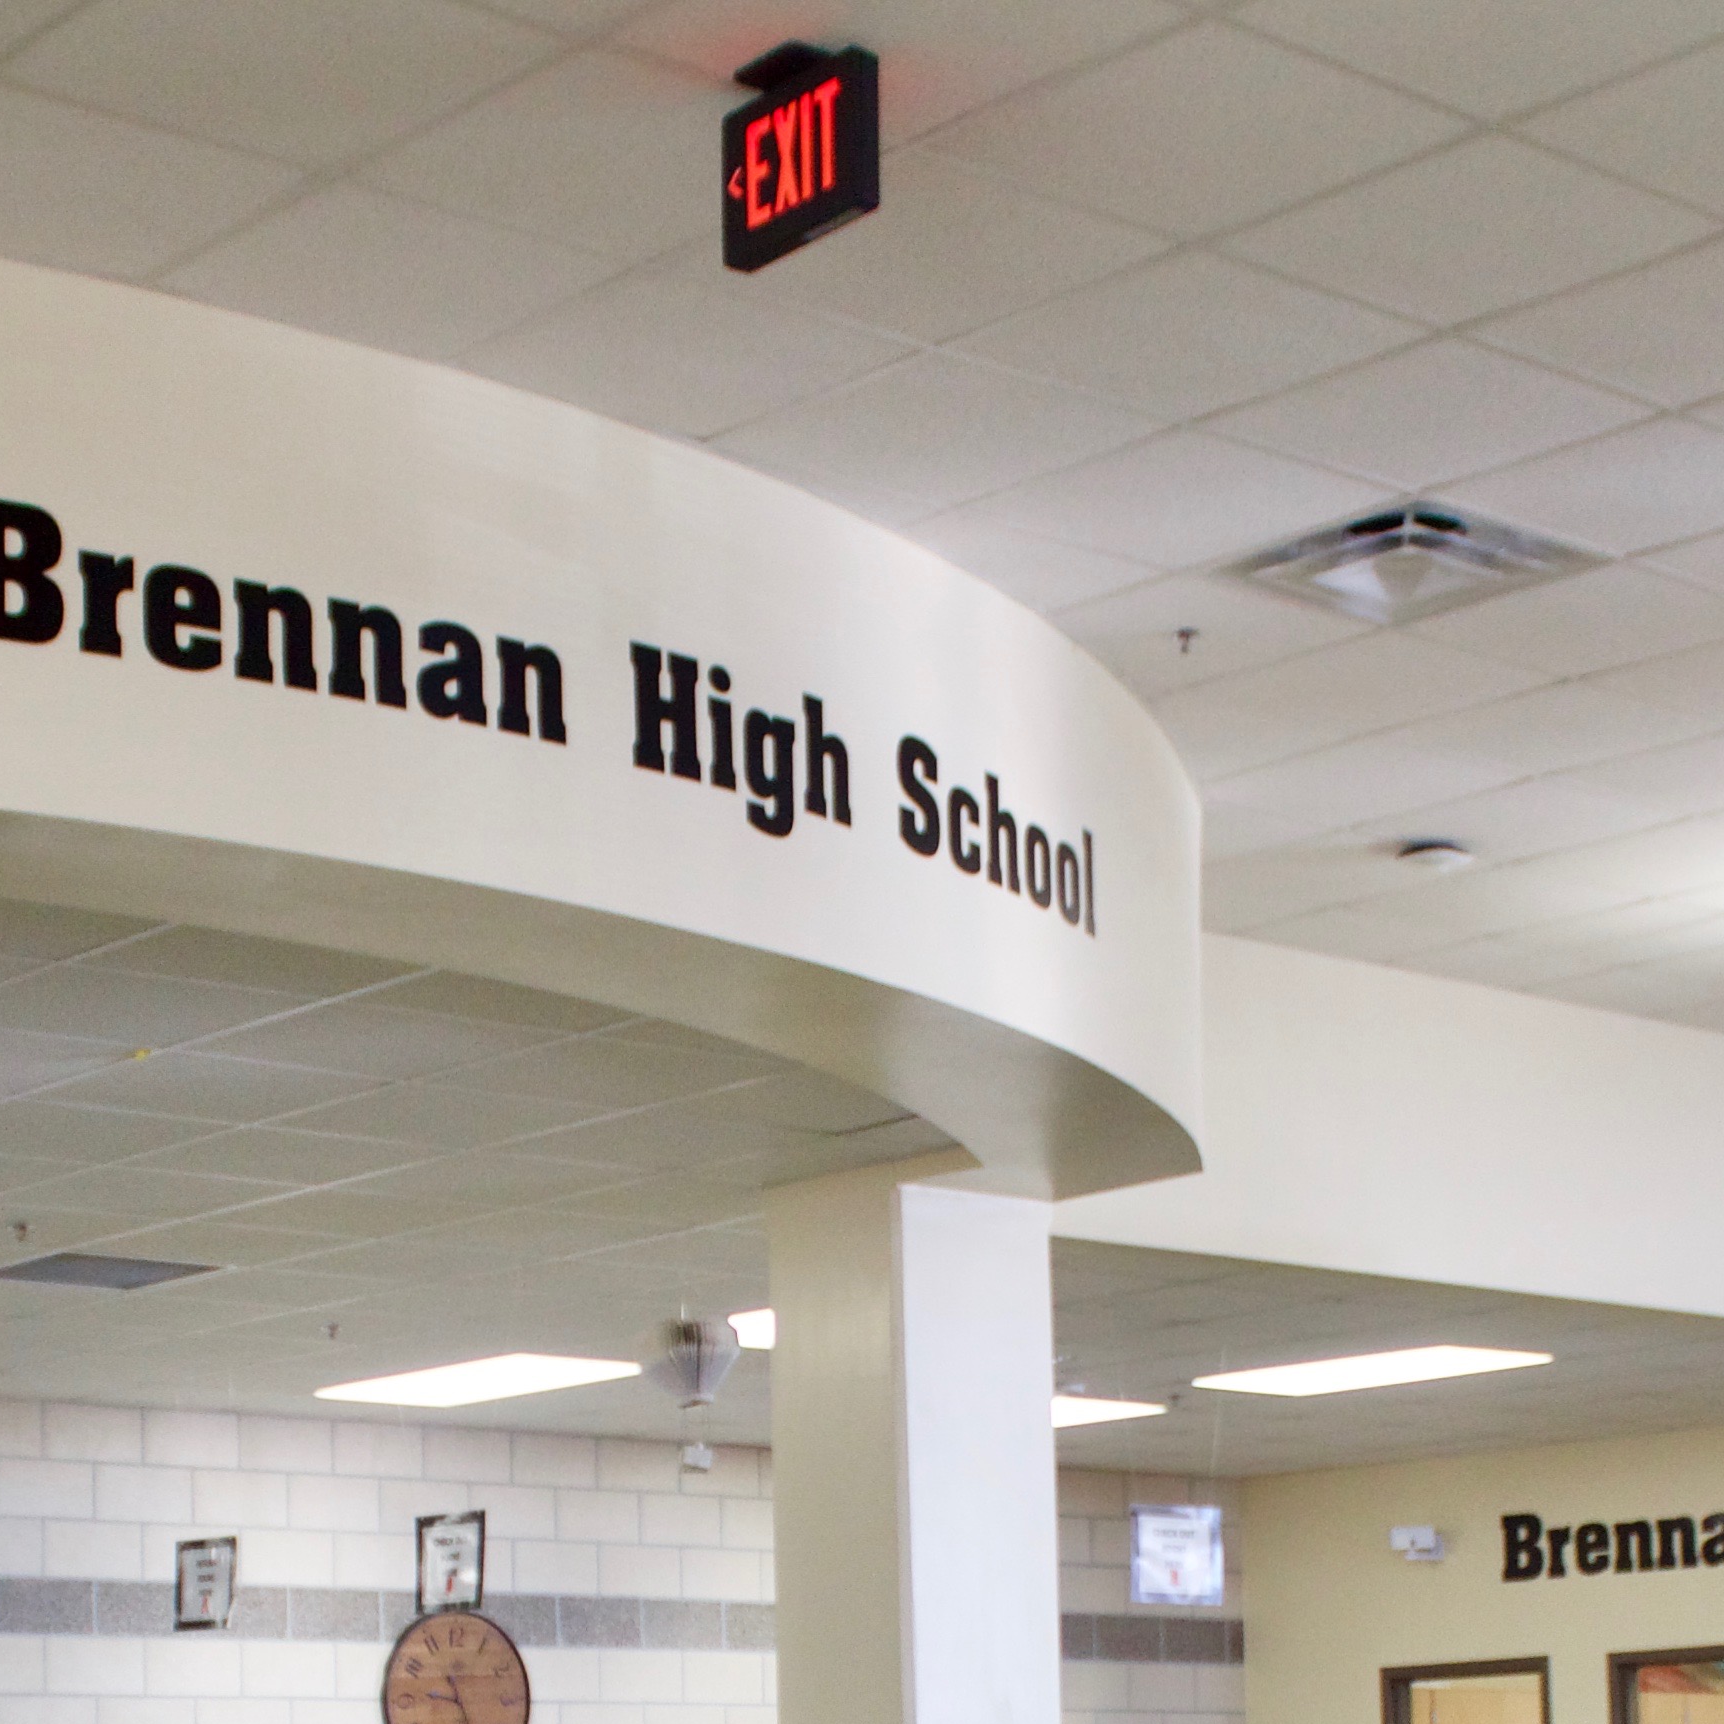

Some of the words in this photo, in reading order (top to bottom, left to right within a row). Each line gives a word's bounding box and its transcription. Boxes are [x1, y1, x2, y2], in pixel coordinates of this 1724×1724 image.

[744, 76, 842, 231] EXIT
[629, 641, 853, 837] High
[898, 736, 1096, 937] School
